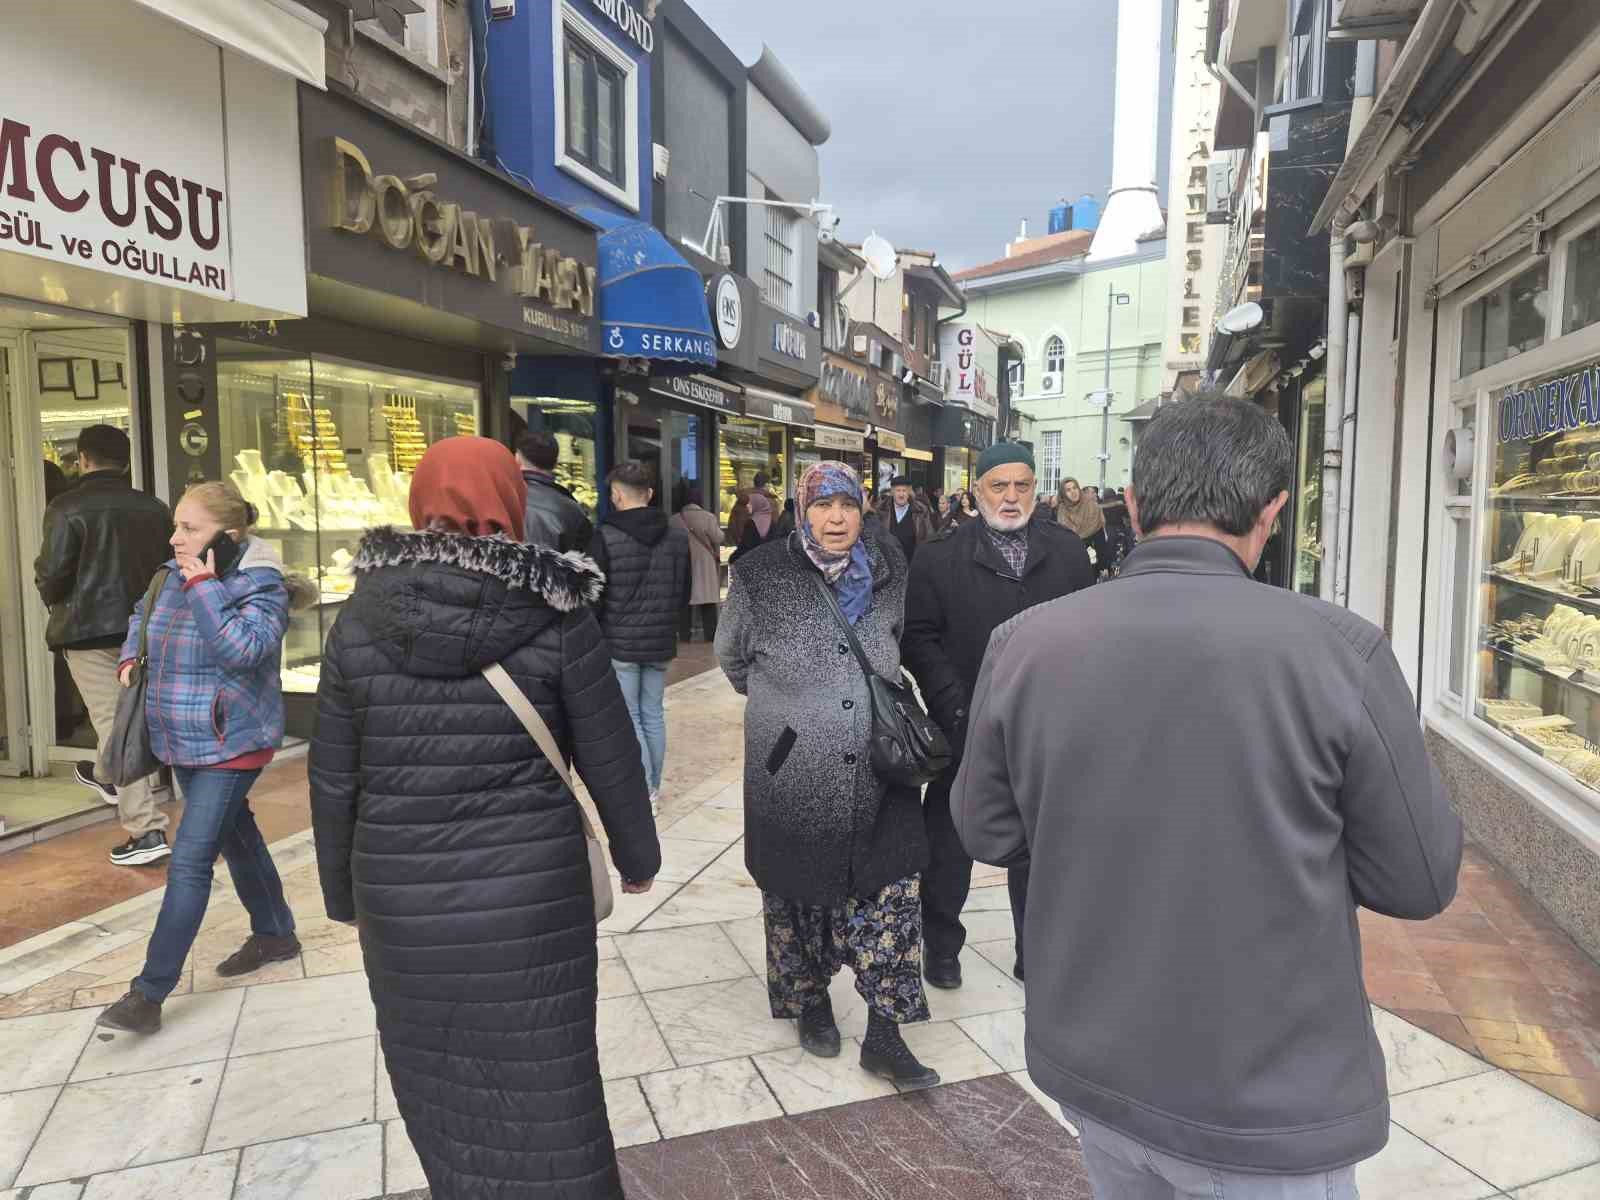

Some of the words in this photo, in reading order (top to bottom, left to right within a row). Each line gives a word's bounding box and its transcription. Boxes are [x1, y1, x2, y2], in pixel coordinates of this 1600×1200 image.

[60, 234, 93, 259] ve
[101, 239, 226, 291] OĞULLARI
[957, 328, 973, 391] GÜL
